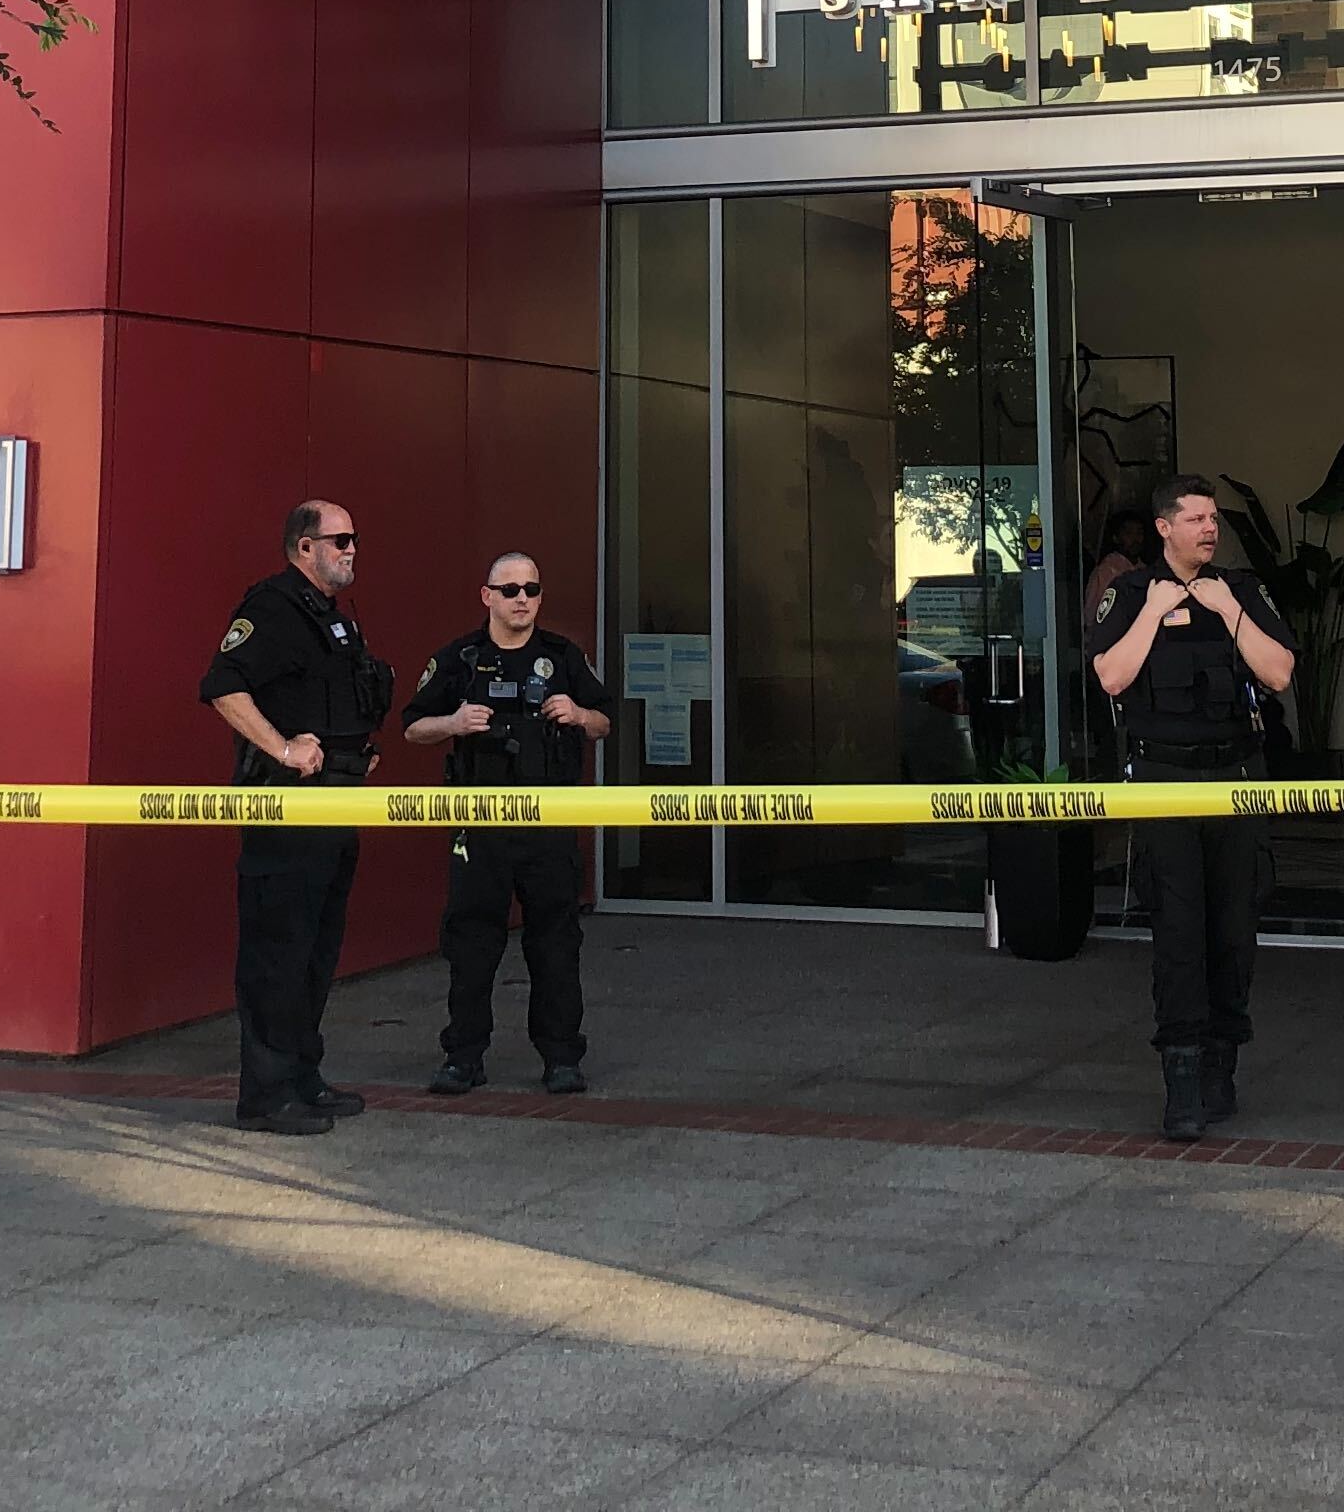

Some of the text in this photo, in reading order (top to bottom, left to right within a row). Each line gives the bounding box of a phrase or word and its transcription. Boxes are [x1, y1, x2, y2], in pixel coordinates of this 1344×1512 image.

[1214, 56, 1282, 85] 1475
[6, 791, 42, 818] POLICE
[140, 793, 284, 821] POLICE LINE DO NOT CROSS
[388, 794, 541, 822] POLICE LINE DO NOT CROSS
[650, 794, 814, 822] POLICE LINE DO NOT CROSS
[931, 791, 1106, 820] POLICE LINE DO NOT CROSS
[1231, 789, 1277, 815] CROSS
[1281, 789, 1309, 814] NOT
[1312, 789, 1333, 813] DO
